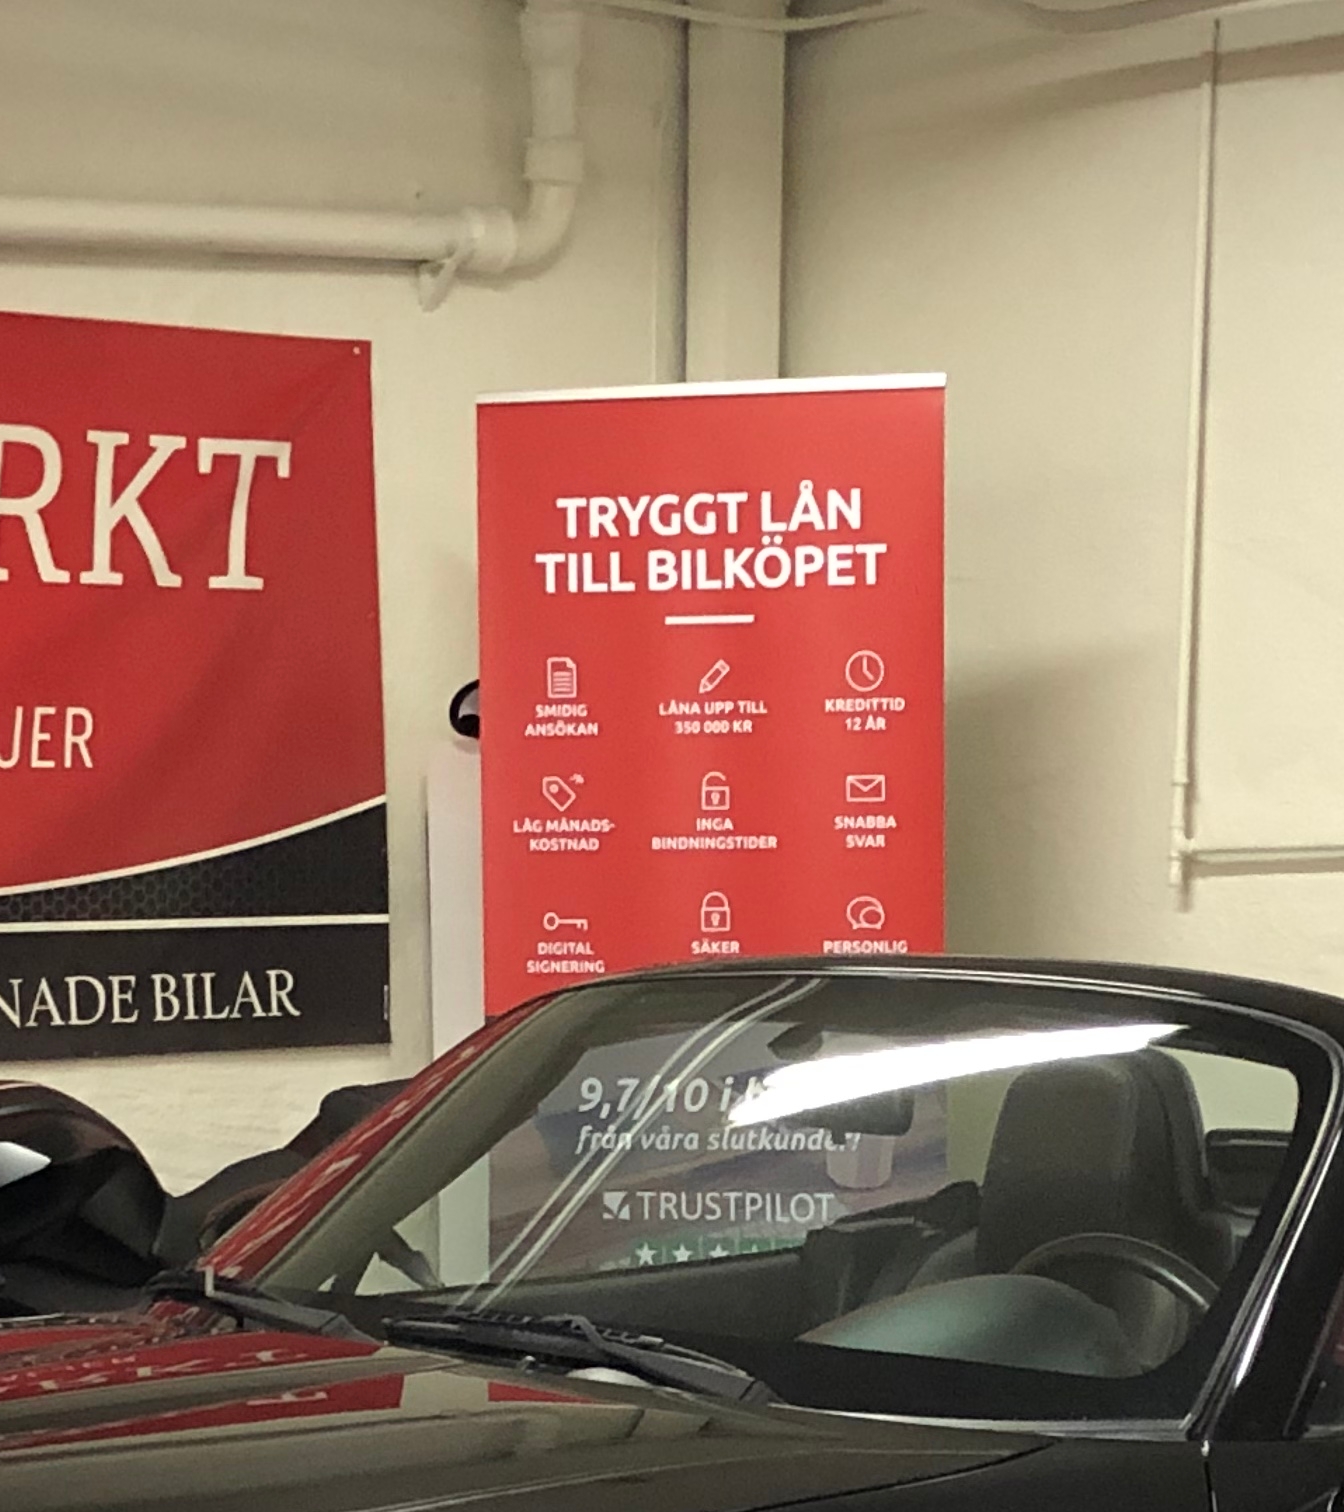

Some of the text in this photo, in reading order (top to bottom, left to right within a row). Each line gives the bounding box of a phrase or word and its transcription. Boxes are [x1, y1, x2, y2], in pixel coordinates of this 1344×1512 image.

[556, 479, 861, 539] TRYGGT LÅN
[535, 535, 888, 594] TILL BILKÖPET
[535, 703, 588, 718] SMIDIG
[658, 699, 768, 716] LÅNA UPP TILL
[824, 697, 906, 713] KREDITTID
[524, 719, 599, 737] ANSÖKAN
[674, 720, 701, 735] 350
[732, 719, 753, 733] KR
[845, 714, 886, 731] 12 ÅR
[513, 817, 543, 833] LÅG
[696, 817, 734, 832] INGA
[834, 815, 897, 830] SNABBA
[529, 837, 600, 852] KOSTNAD
[651, 835, 778, 850] BINDNINGSTIDER
[845, 834, 886, 849] SVAR
[537, 941, 594, 956] DIGITAL
[690, 938, 740, 955] SÄKER
[822, 940, 908, 955] PERSONLIG
[526, 959, 605, 974] SIGNERING
[150, 969, 301, 1022] BILAR
[641, 1125, 699, 1150] våra
[636, 1191, 836, 1223] TRUSTPILOT
